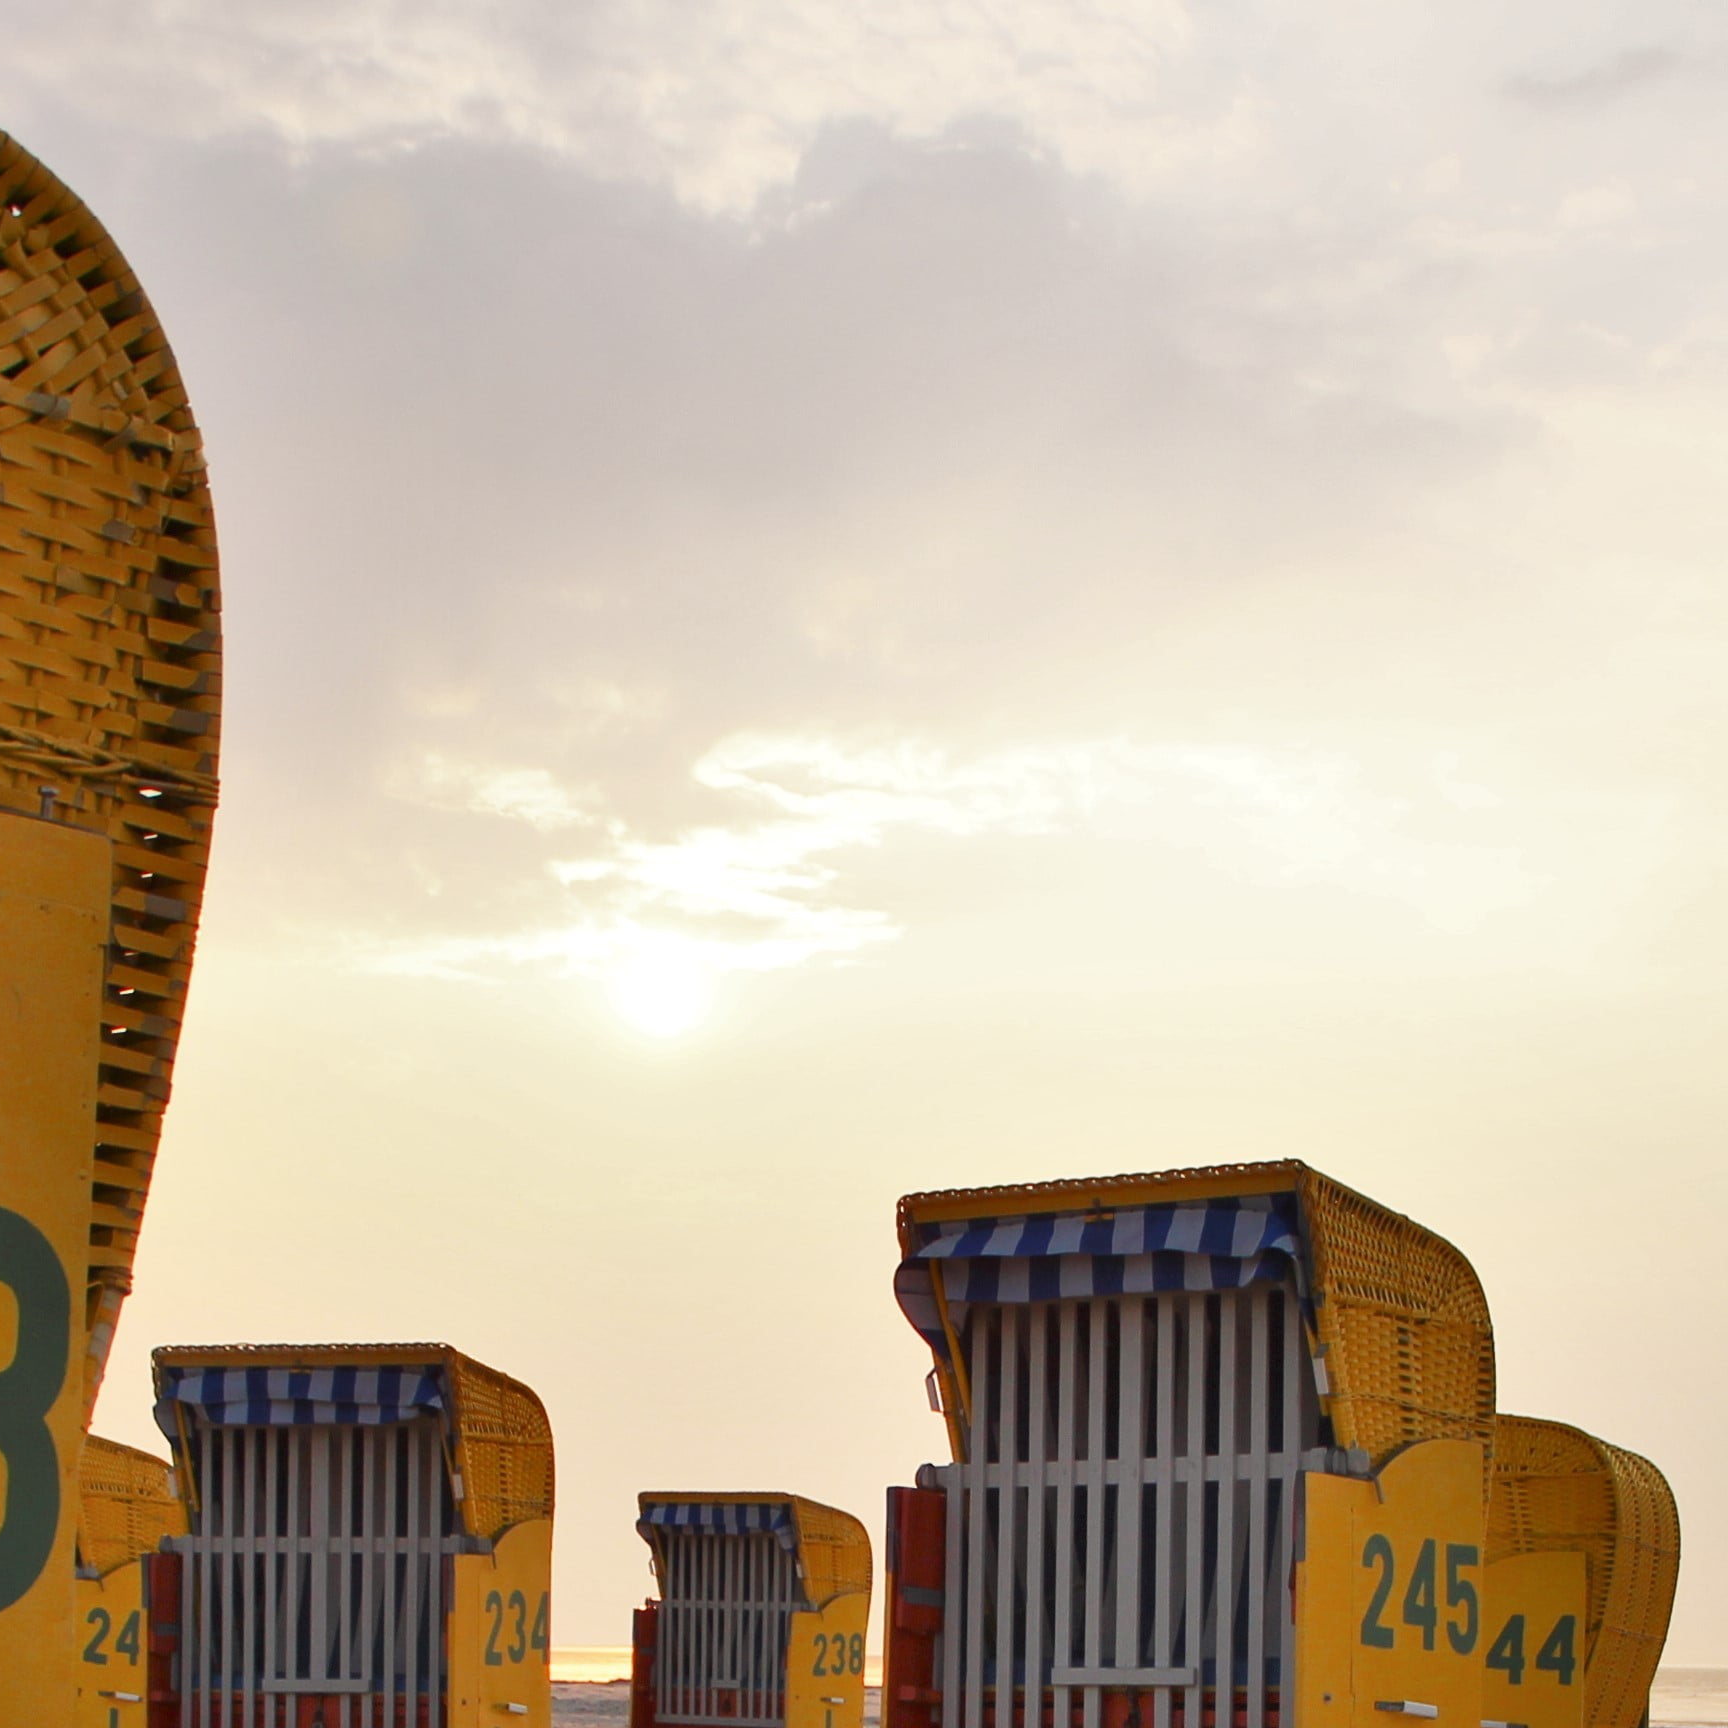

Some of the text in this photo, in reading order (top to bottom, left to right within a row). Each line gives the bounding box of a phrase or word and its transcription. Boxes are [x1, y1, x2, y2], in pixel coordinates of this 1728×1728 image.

[484, 1589, 549, 1666] 234
[1360, 1533, 1480, 1655] 245
[813, 1633, 863, 1676] 238
